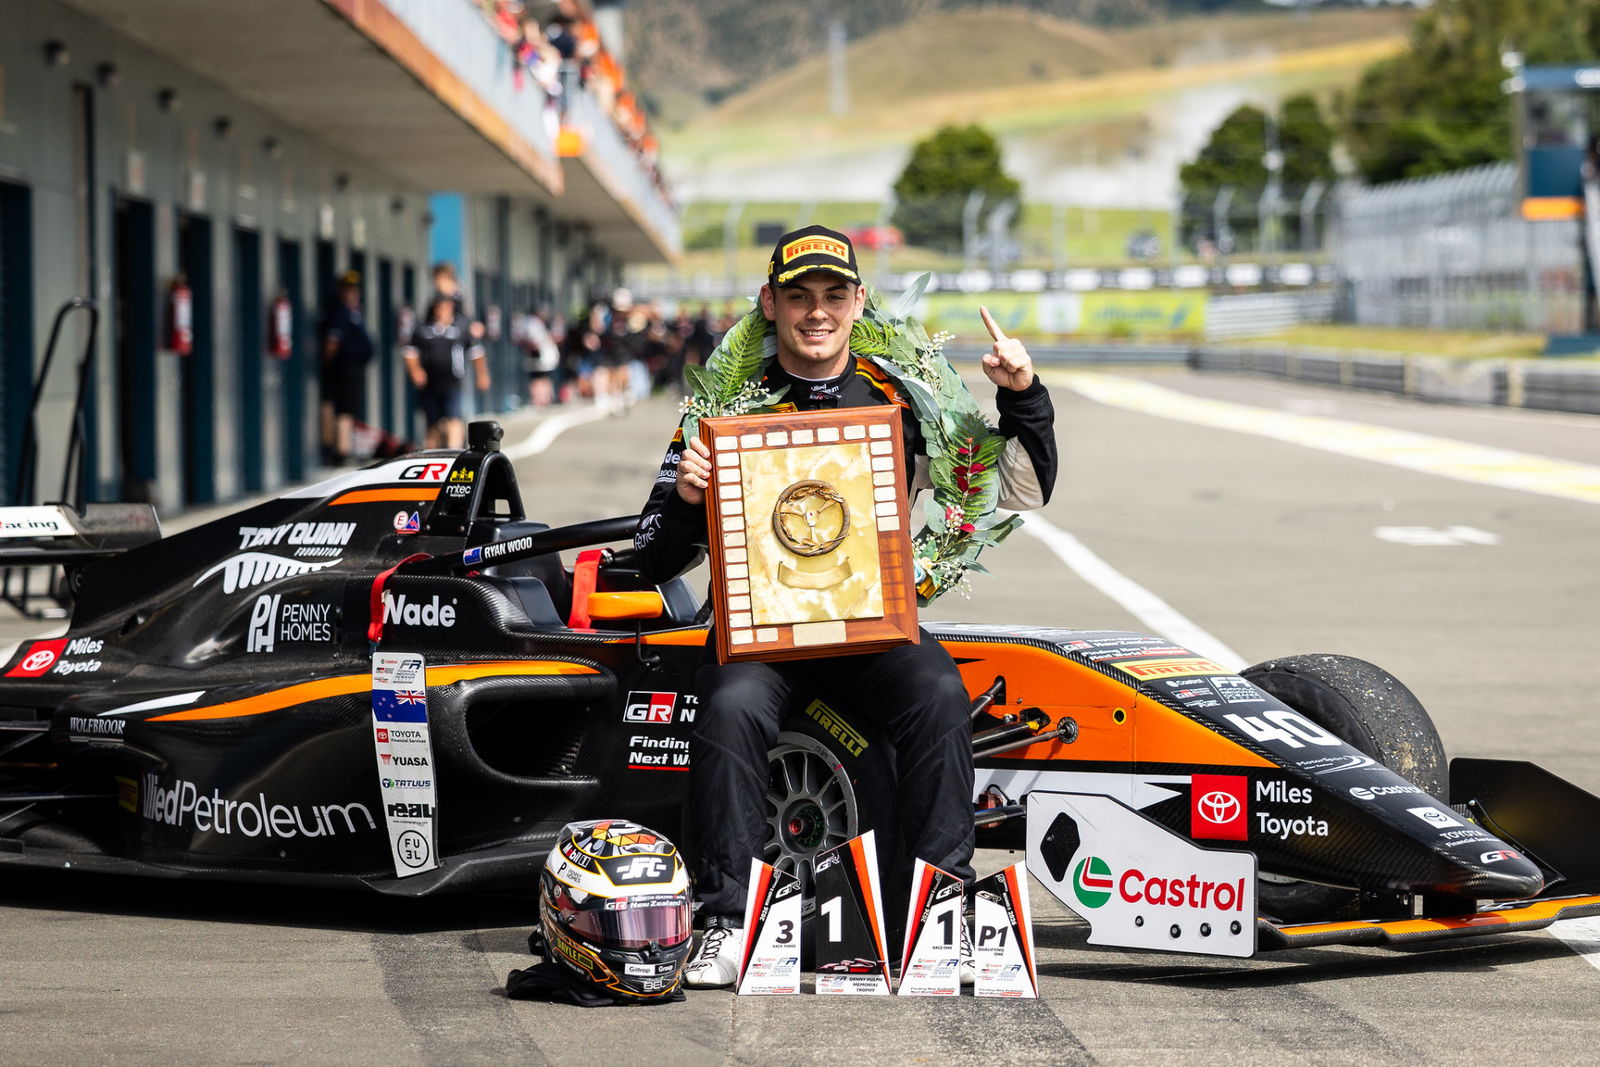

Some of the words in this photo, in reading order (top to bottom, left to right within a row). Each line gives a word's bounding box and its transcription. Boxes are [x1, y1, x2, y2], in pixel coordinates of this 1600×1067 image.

[786, 238, 846, 259] PIRELLI
[664, 449, 681, 465] de
[399, 463, 448, 480] GR
[446, 484, 472, 494] mtec
[0, 520, 58, 530] acing
[288, 522, 357, 545] QUINN
[484, 542, 506, 559] RYAN
[507, 536, 533, 552] WOOD
[282, 604, 331, 622] PENNY
[281, 623, 331, 641] HOMES
[65, 637, 104, 655] Miles
[53, 659, 102, 676] Toyota
[1125, 661, 1223, 676] PIRELLI
[627, 704, 672, 721] GR
[70, 717, 124, 734] WOLFBROOK
[390, 730, 421, 738] TOYOTA
[805, 699, 869, 758] PIRELLI
[1223, 709, 1342, 749] 40
[392, 756, 429, 766] YUASA
[629, 752, 668, 765] Next
[1256, 781, 1312, 804] Miles
[1256, 812, 1328, 840] Toyota
[1439, 829, 1487, 840] TOYOTA
[563, 842, 582, 863] Mobil
[1480, 849, 1521, 864] GR
[816, 851, 840, 873] GR
[776, 880, 801, 899] GR
[936, 881, 961, 899] GR
[1119, 869, 1245, 912] Castrol
[606, 901, 627, 910] GR
[759, 906, 769, 922] 2026
[820, 896, 842, 942] 1
[1008, 910, 1017, 925] 2026
[775, 919, 794, 944] 3
[937, 909, 953, 945] 1
[978, 925, 1008, 947] P1
